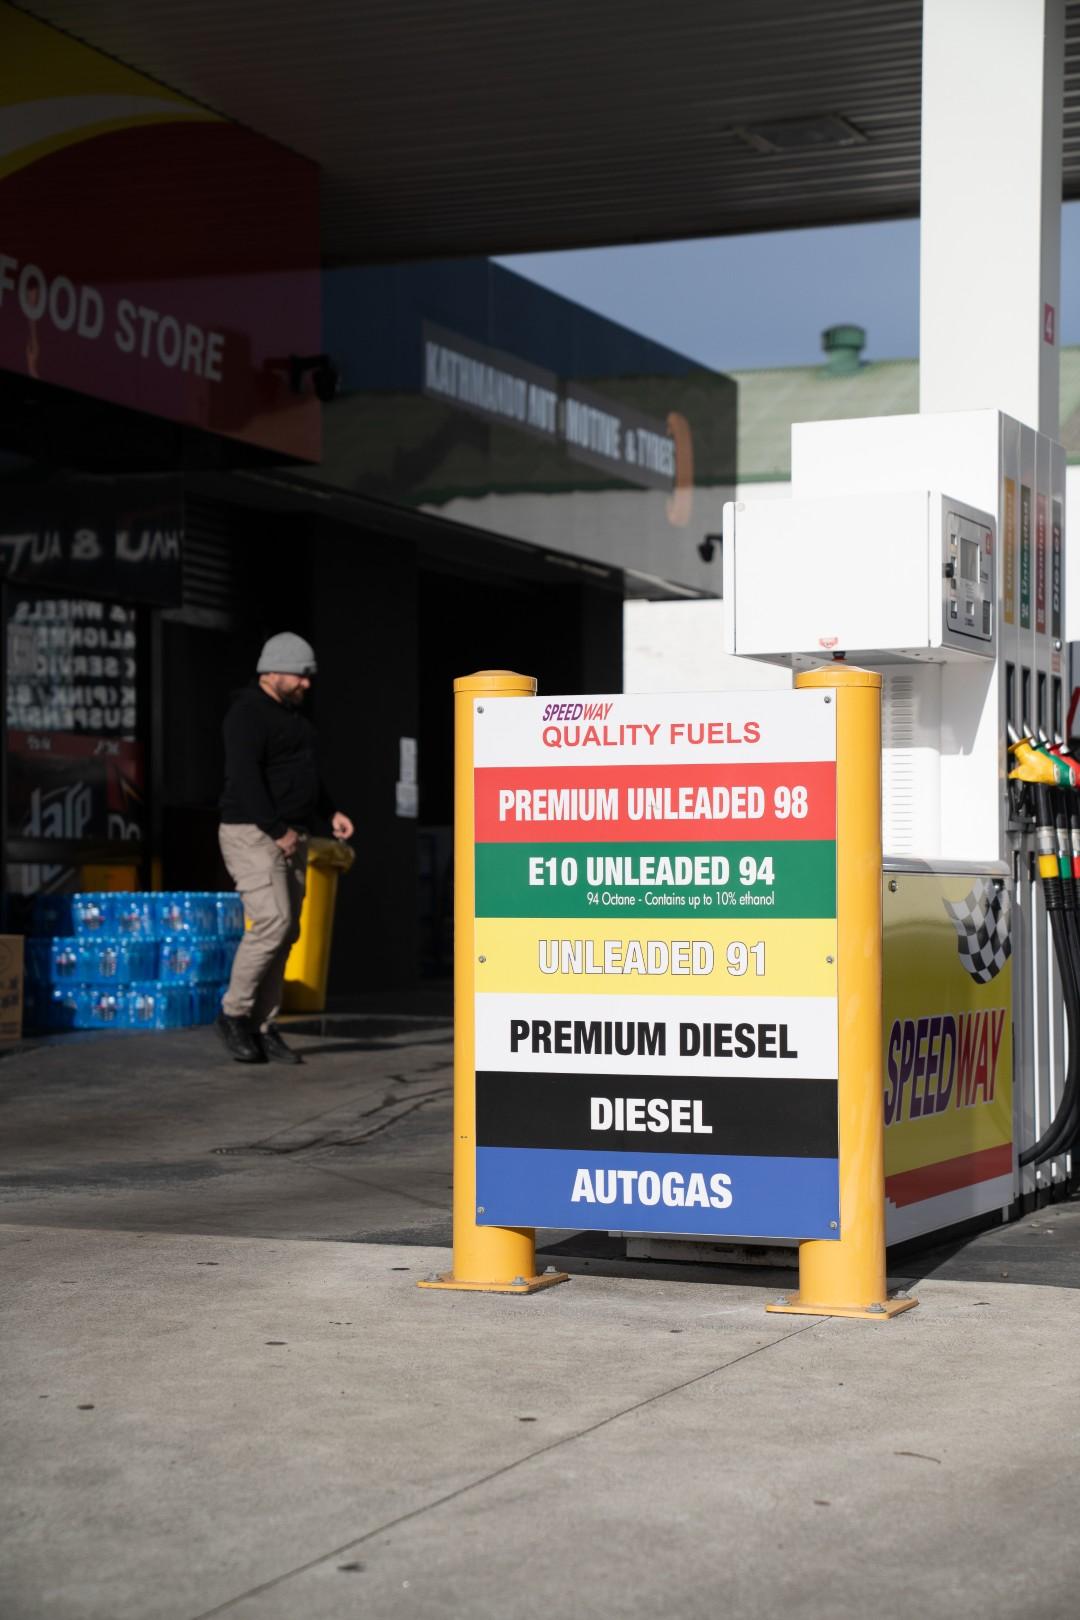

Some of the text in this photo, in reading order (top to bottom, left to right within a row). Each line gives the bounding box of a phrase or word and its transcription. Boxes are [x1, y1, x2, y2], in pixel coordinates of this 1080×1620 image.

[0, 254, 225, 382] FOOD STORE
[1052, 527, 1060, 613] Diesel
[542, 703, 613, 721] SPEEDWAY
[542, 722, 761, 748] QUALITY FUELS
[499, 786, 808, 821] PREMIUM UNLEADED 98
[529, 856, 775, 886] E10 UNLEADED 94
[587, 892, 599, 906] 94
[602, 892, 635, 906] Octane
[645, 892, 685, 906] Contains
[689, 895, 700, 909] up
[703, 893, 712, 906] to
[716, 891, 736, 906] 10%
[739, 891, 775, 906] ethanol
[538, 939, 765, 976] UNLEADED 91
[510, 1019, 798, 1058] PREMIUM DIESEL
[884, 1008, 1006, 1127] SPEEDWAY
[590, 1097, 713, 1134] DIESEL
[571, 1168, 733, 1209] AUTOGAS
